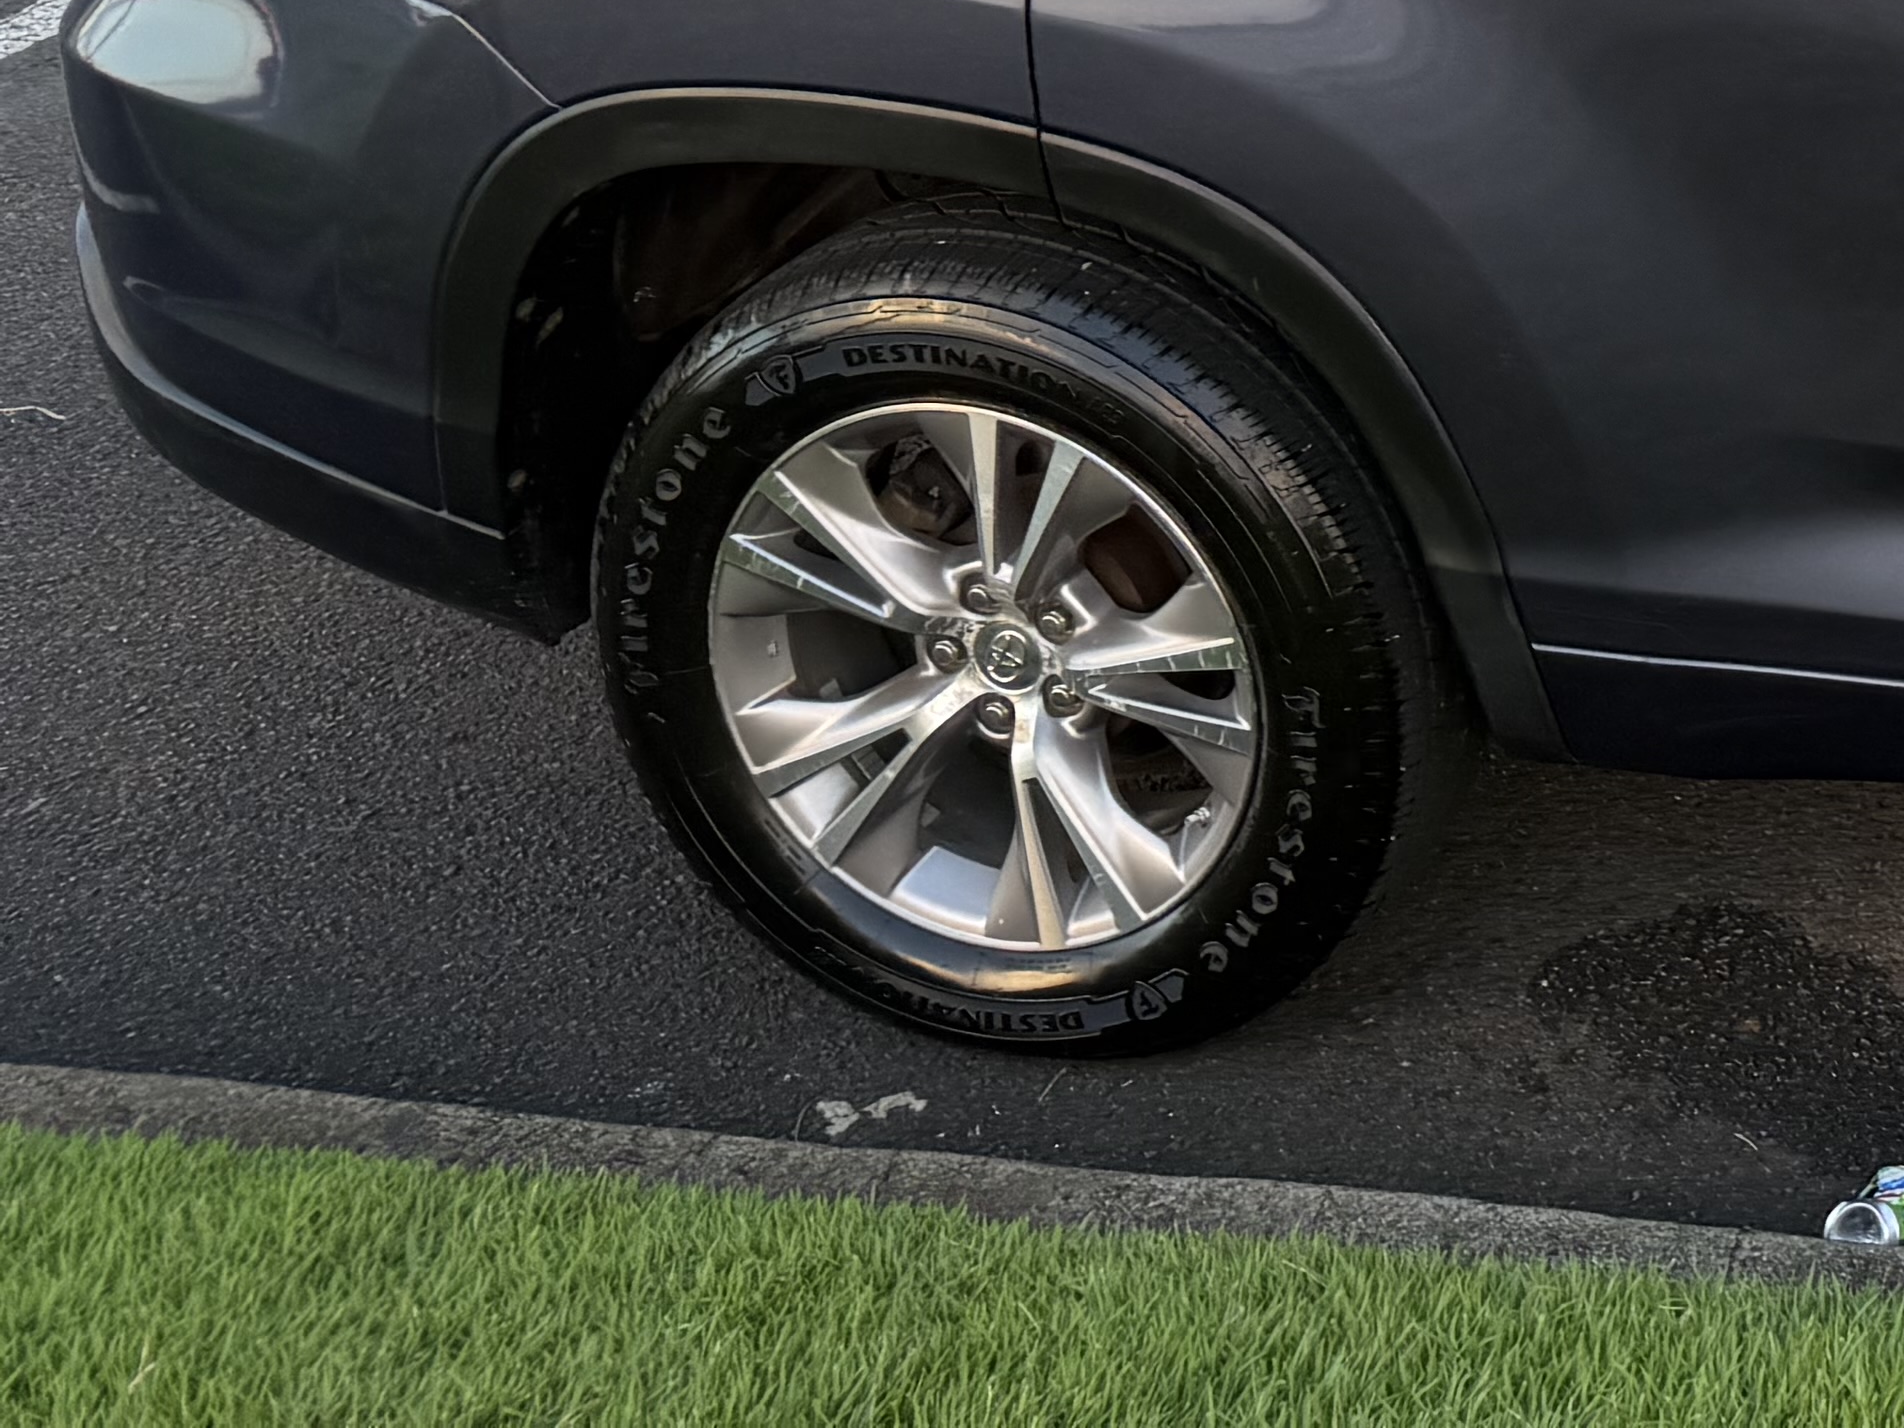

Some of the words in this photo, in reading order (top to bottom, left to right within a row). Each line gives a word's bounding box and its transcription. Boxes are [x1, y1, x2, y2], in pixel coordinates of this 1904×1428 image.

[841, 344, 1077, 398] DESTINATION
[614, 406, 732, 696] Firestone
[1199, 685, 1326, 974] Firestone
